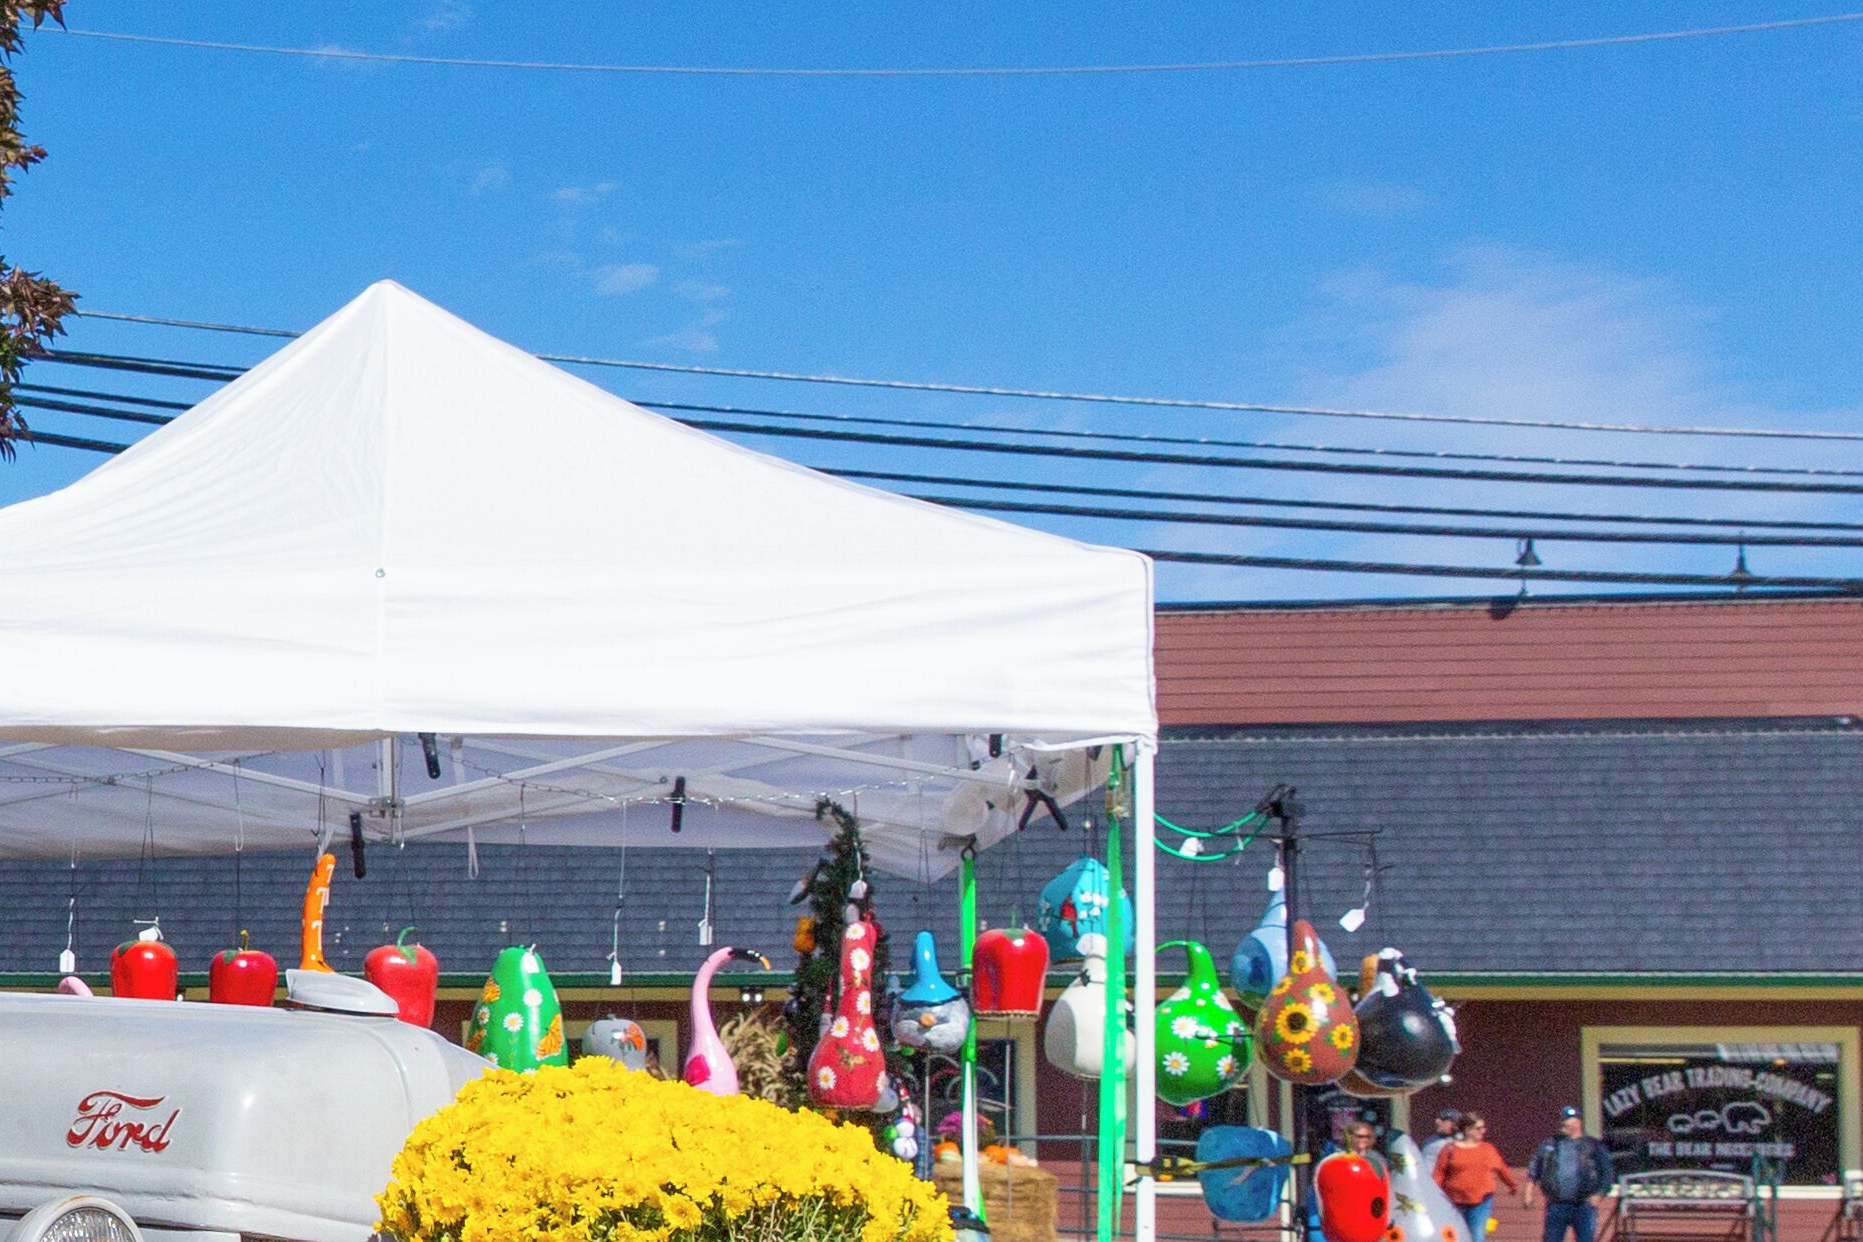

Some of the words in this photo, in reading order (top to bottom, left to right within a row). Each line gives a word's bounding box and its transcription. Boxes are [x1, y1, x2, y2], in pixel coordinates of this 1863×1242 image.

[1603, 1083, 1641, 1117] LAZY
[1641, 1070, 1685, 1100] BEAR
[1685, 1066, 1754, 1088] TRADING
[1755, 1072, 1832, 1112] COMPANY
[67, 1091, 180, 1153] Ford
[1648, 1141, 1672, 1157] THE
[1675, 1141, 1713, 1157] BEAR
